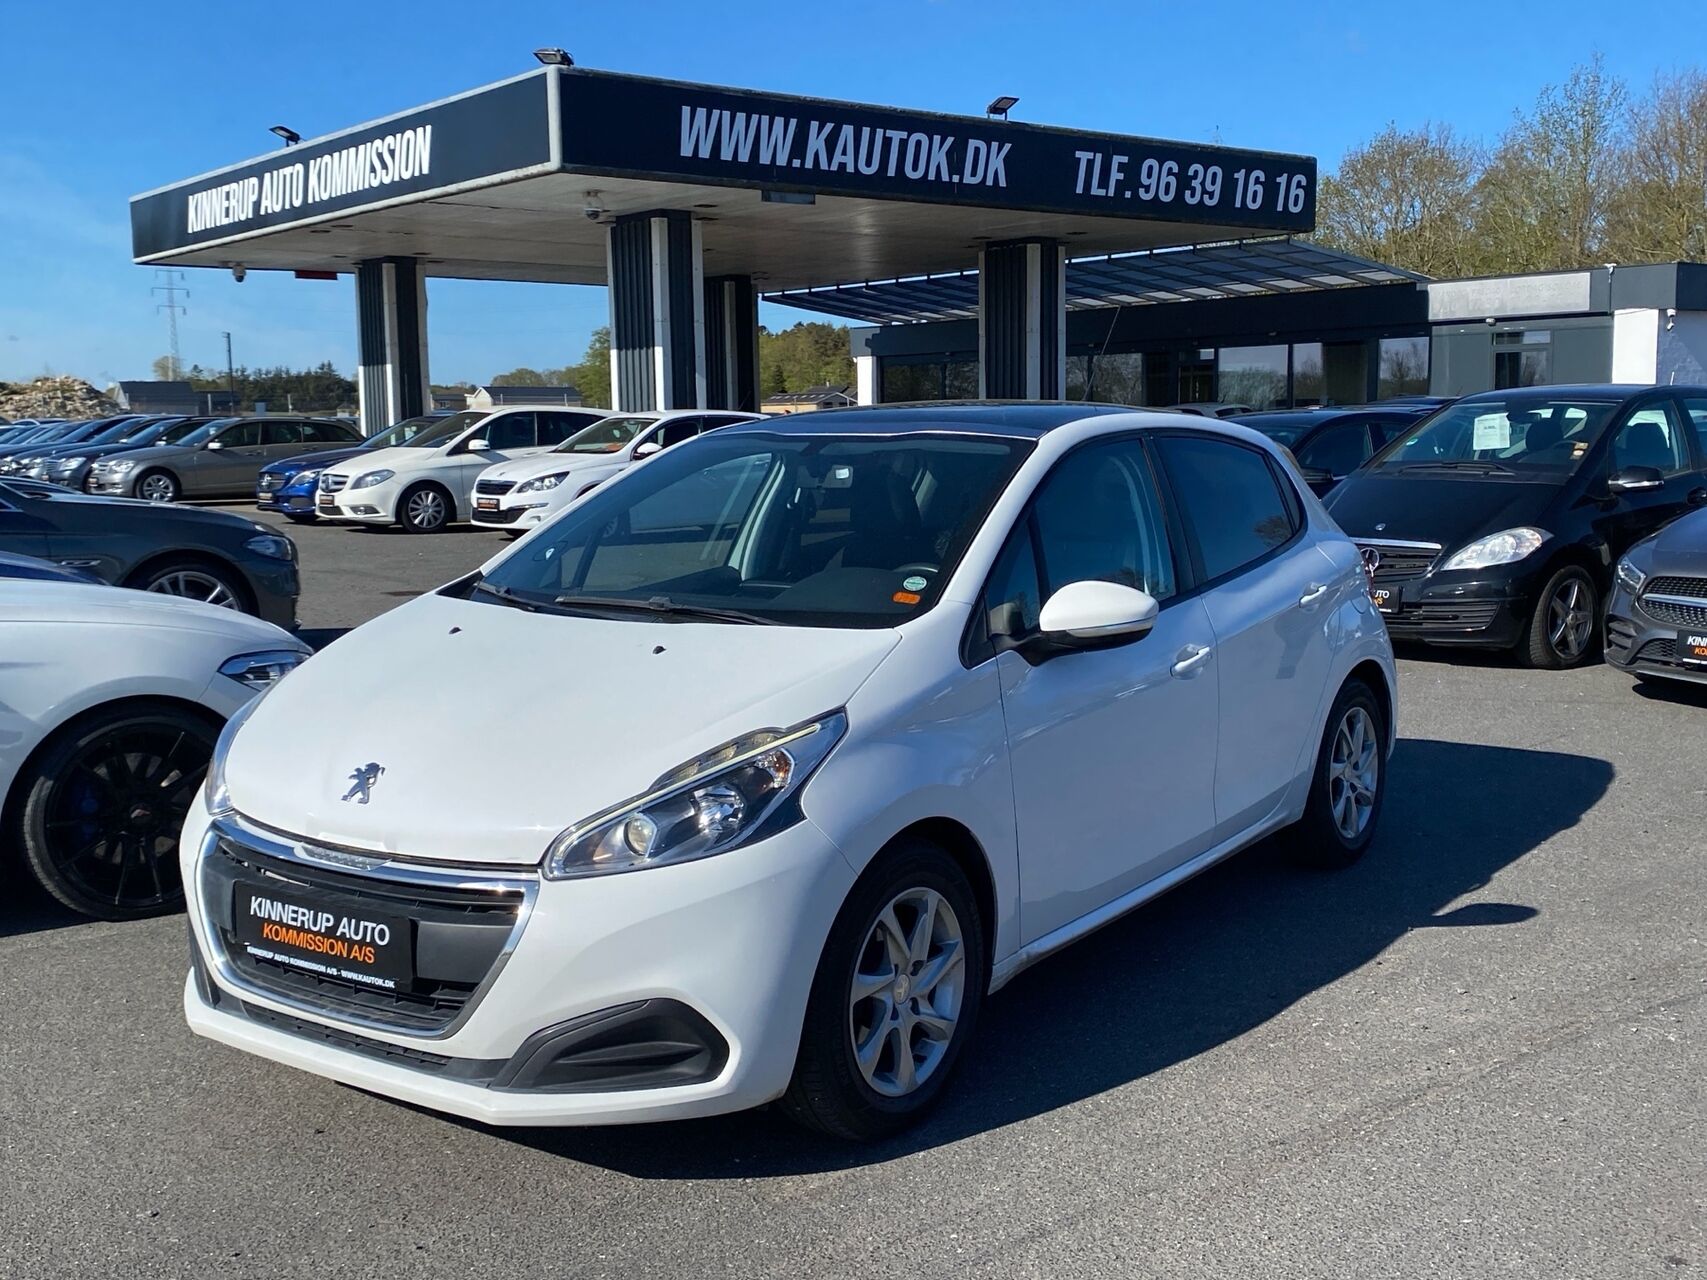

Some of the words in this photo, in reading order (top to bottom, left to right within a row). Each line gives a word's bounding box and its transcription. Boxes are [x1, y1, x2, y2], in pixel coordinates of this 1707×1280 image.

[680, 105, 1012, 187] WWW.KAUTOK.DK
[187, 176, 259, 234] KINNERUP
[259, 162, 305, 216] AUTO
[307, 124, 432, 204] KOMMISSION
[1075, 150, 1132, 198] TLF.
[1138, 158, 1179, 203] 96
[1184, 163, 1223, 207] 39
[1233, 168, 1266, 210] 16
[1275, 172, 1307, 213] 16
[250, 896, 335, 934] KINNERUP
[336, 917, 391, 946] AUTO
[262, 922, 349, 959] KOMMISSION
[349, 944, 376, 964] A/S
[273, 953, 290, 964] AUTO
[340, 969, 396, 989] WWW.KAUTOK.DK
